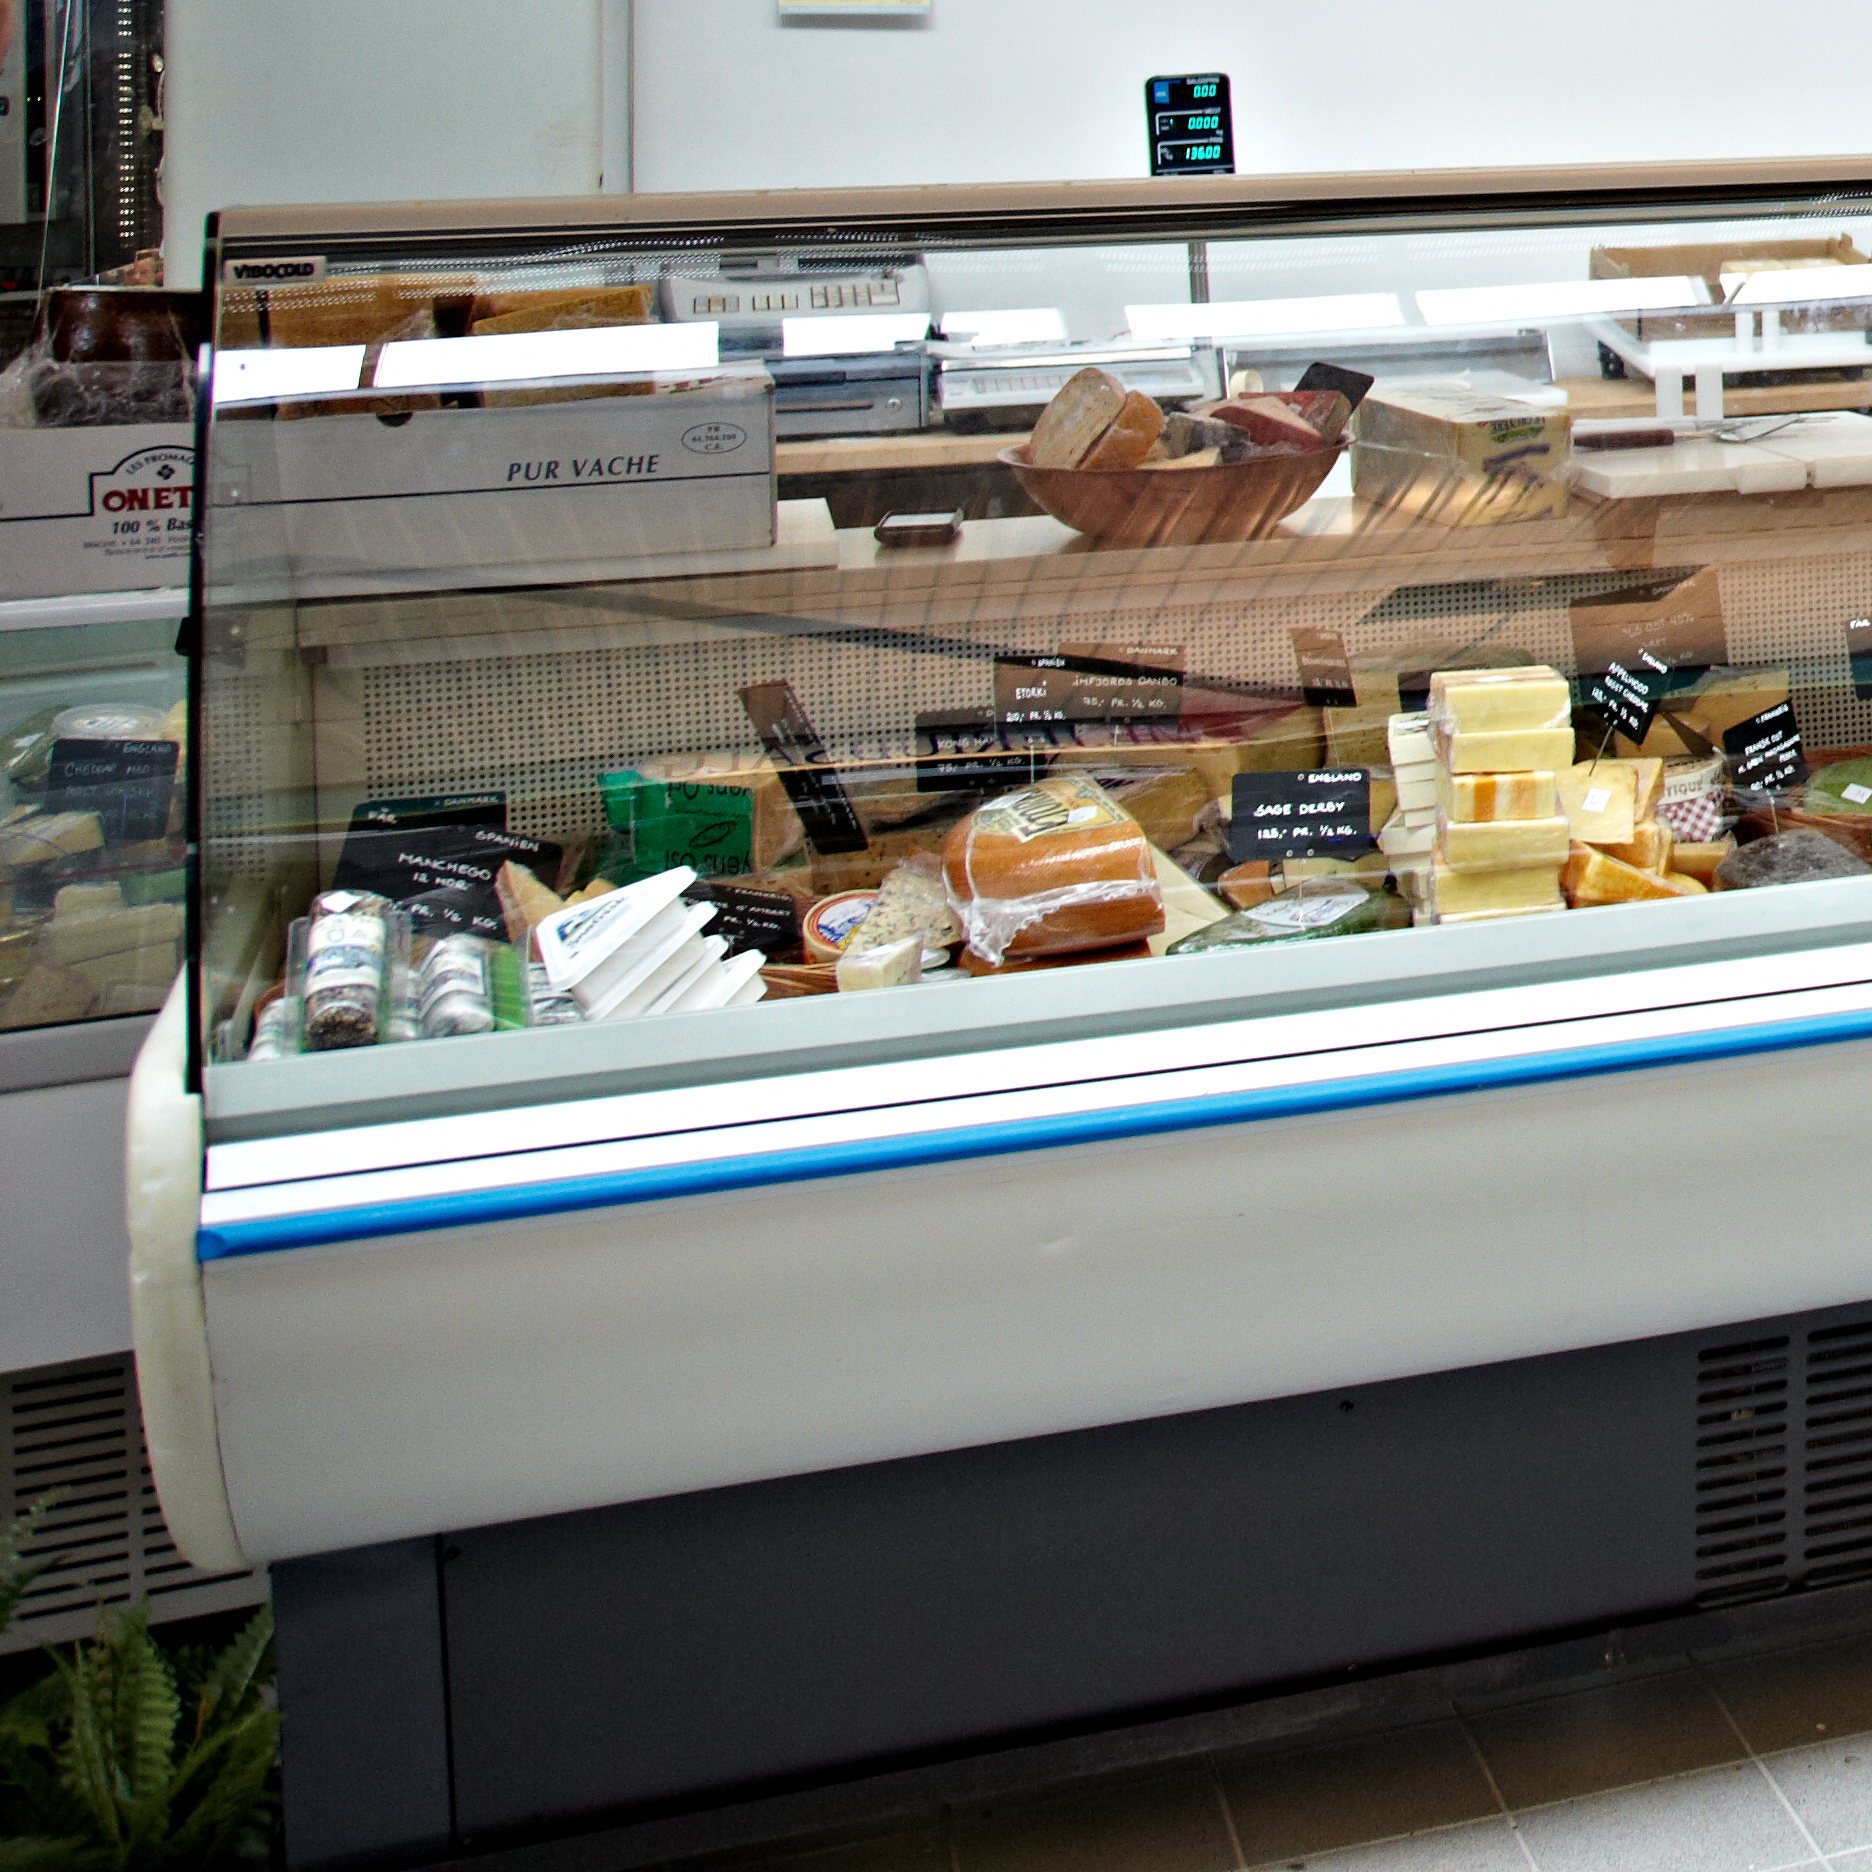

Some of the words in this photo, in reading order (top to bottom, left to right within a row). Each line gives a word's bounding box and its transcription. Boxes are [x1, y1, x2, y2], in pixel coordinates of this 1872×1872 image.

[233, 262, 315, 280] VIBOCOLD
[507, 460, 560, 483] PUR
[572, 453, 660, 478] VACHE
[111, 520, 142, 535] 100
[145, 519, 161, 533] %
[1124, 646, 1179, 657] DANMARK
[937, 736, 970, 750] KONG
[1307, 772, 1363, 785] ENGLAND
[1252, 802, 1293, 818] SAGE
[1298, 801, 1346, 816] DERBY
[397, 851, 493, 882] MANCHEGO
